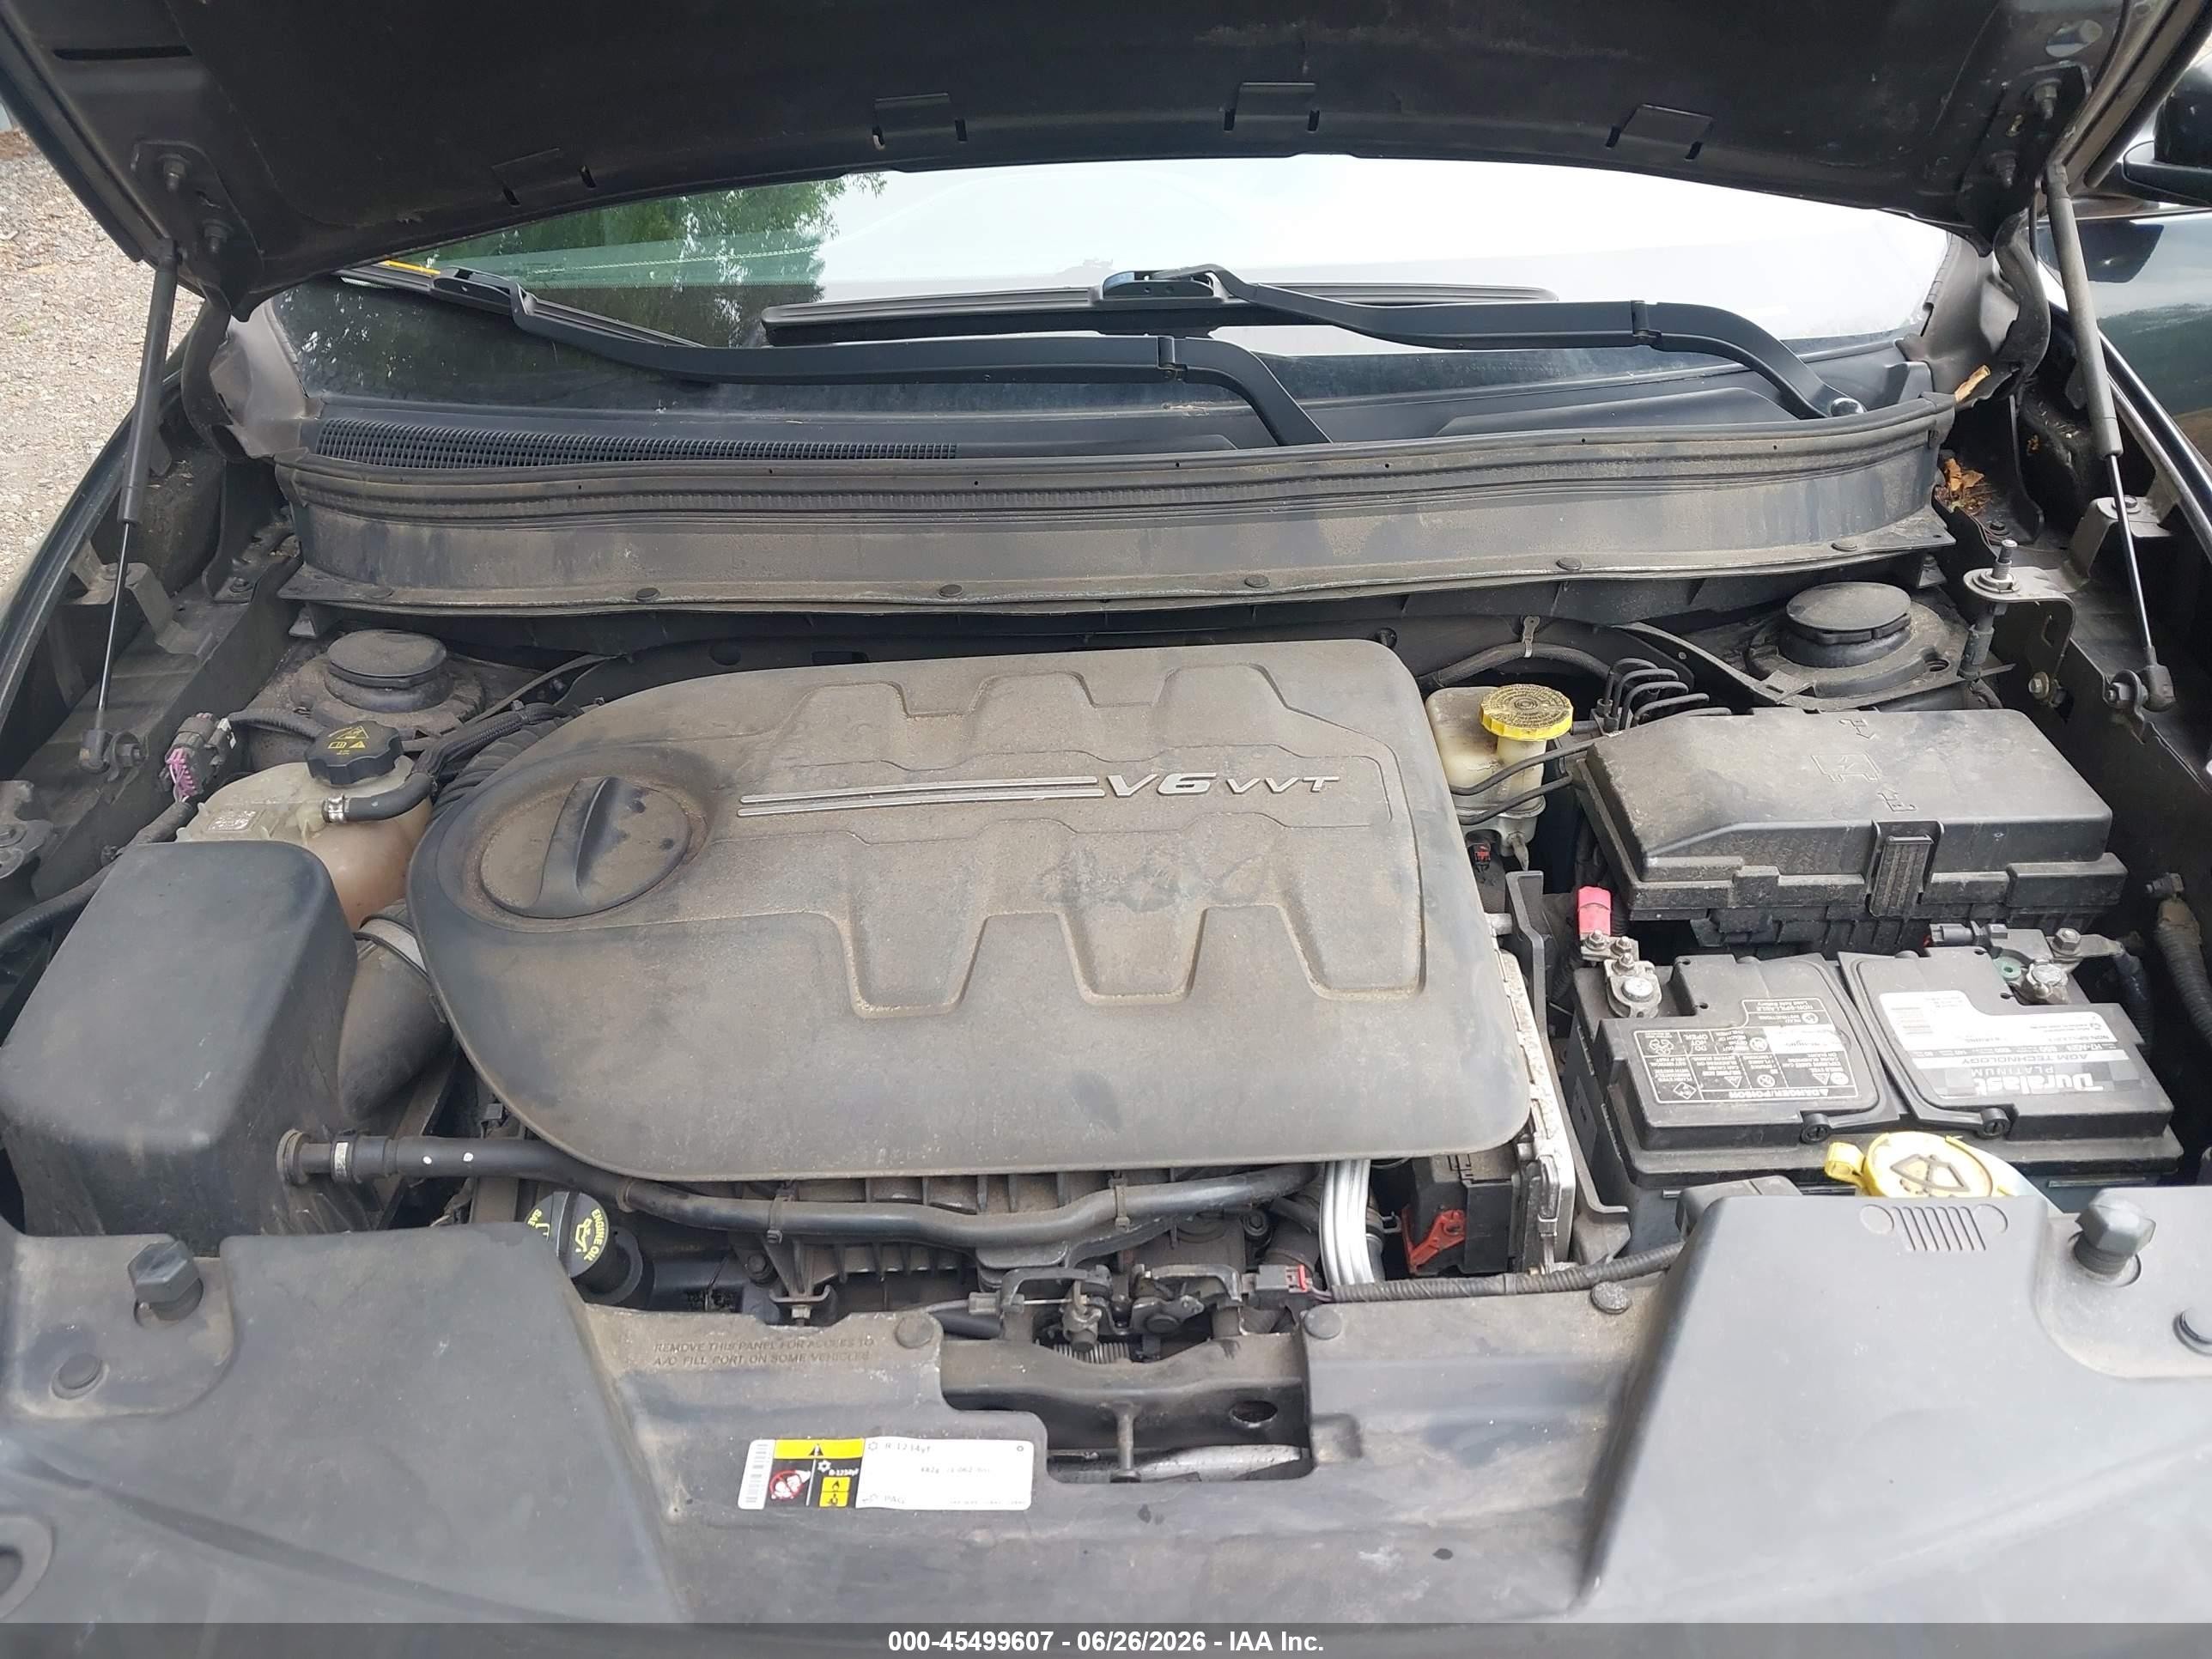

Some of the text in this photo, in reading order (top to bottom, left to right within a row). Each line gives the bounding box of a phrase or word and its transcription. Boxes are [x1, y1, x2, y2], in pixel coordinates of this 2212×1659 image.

[1107, 772, 1341, 798] V6 VVT
[1961, 1055, 2054, 1065] TECHNOLOGY
[1971, 1065, 2055, 1078] PLATINUM
[1973, 1073, 2104, 1097] Duralast
[527, 1208, 543, 1227] SAE
[584, 1208, 605, 1261] ENGINE OIL
[653, 1342, 705, 1352] REMOVE
